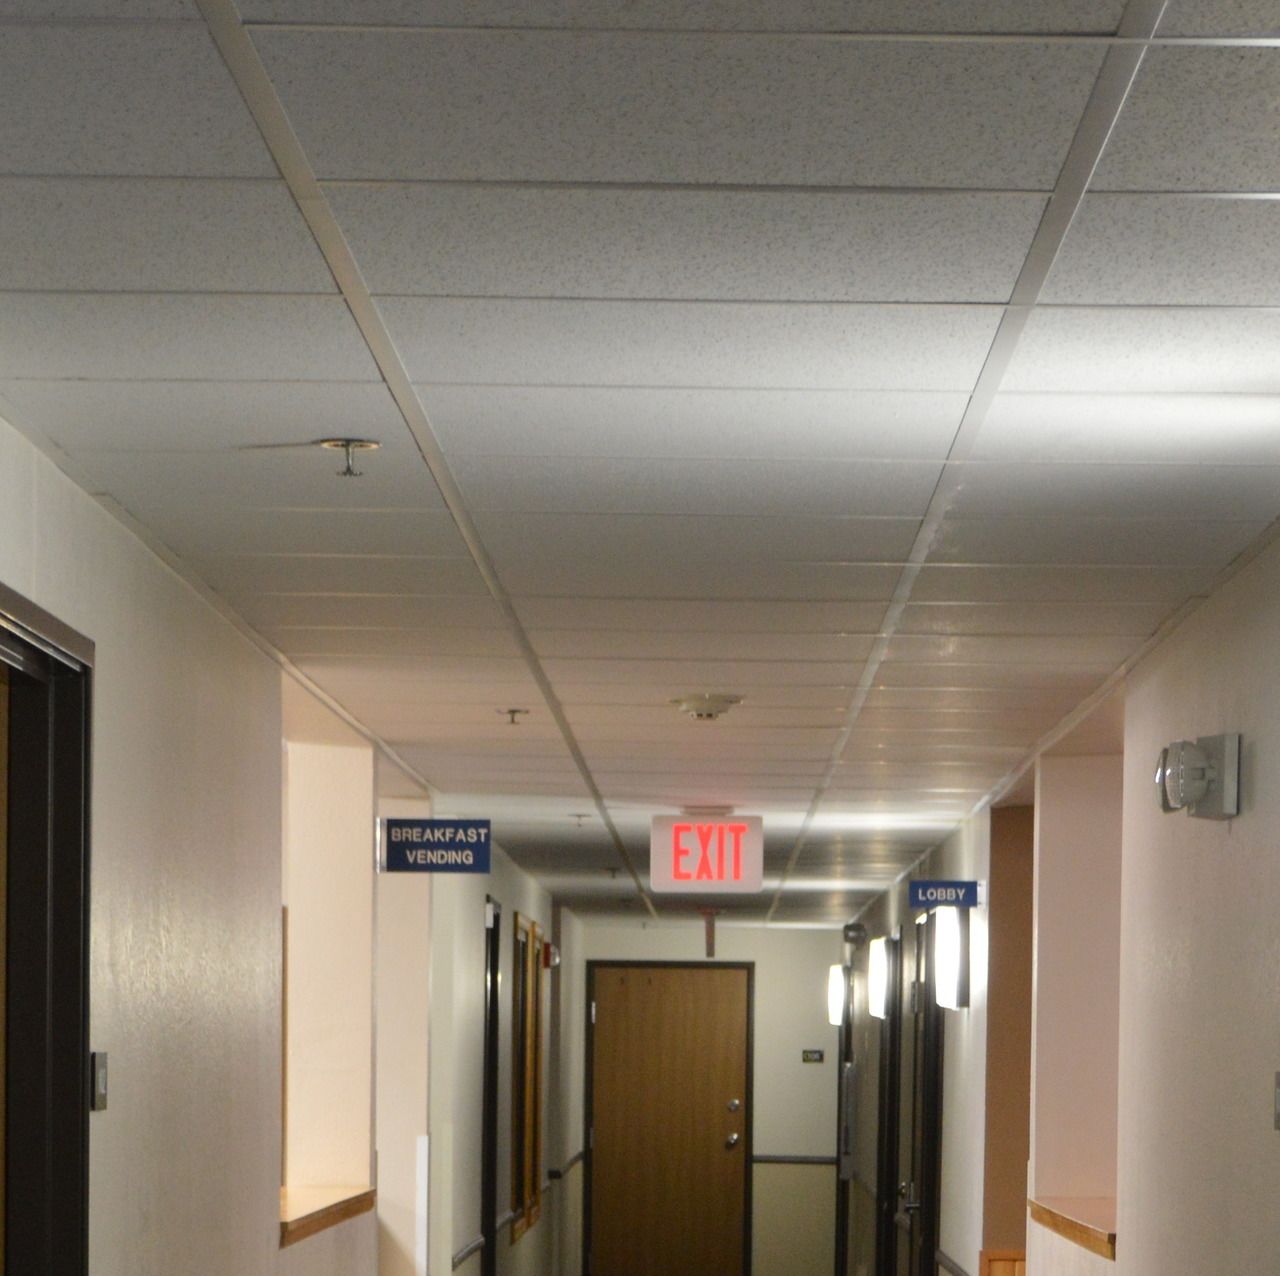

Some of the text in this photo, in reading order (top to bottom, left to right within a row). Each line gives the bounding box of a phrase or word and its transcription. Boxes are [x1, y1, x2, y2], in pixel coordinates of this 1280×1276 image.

[390, 827, 489, 843] BREAKFAST
[405, 849, 474, 865] VENDING
[671, 822, 749, 881] EXIT
[917, 887, 966, 901] LOBBY
